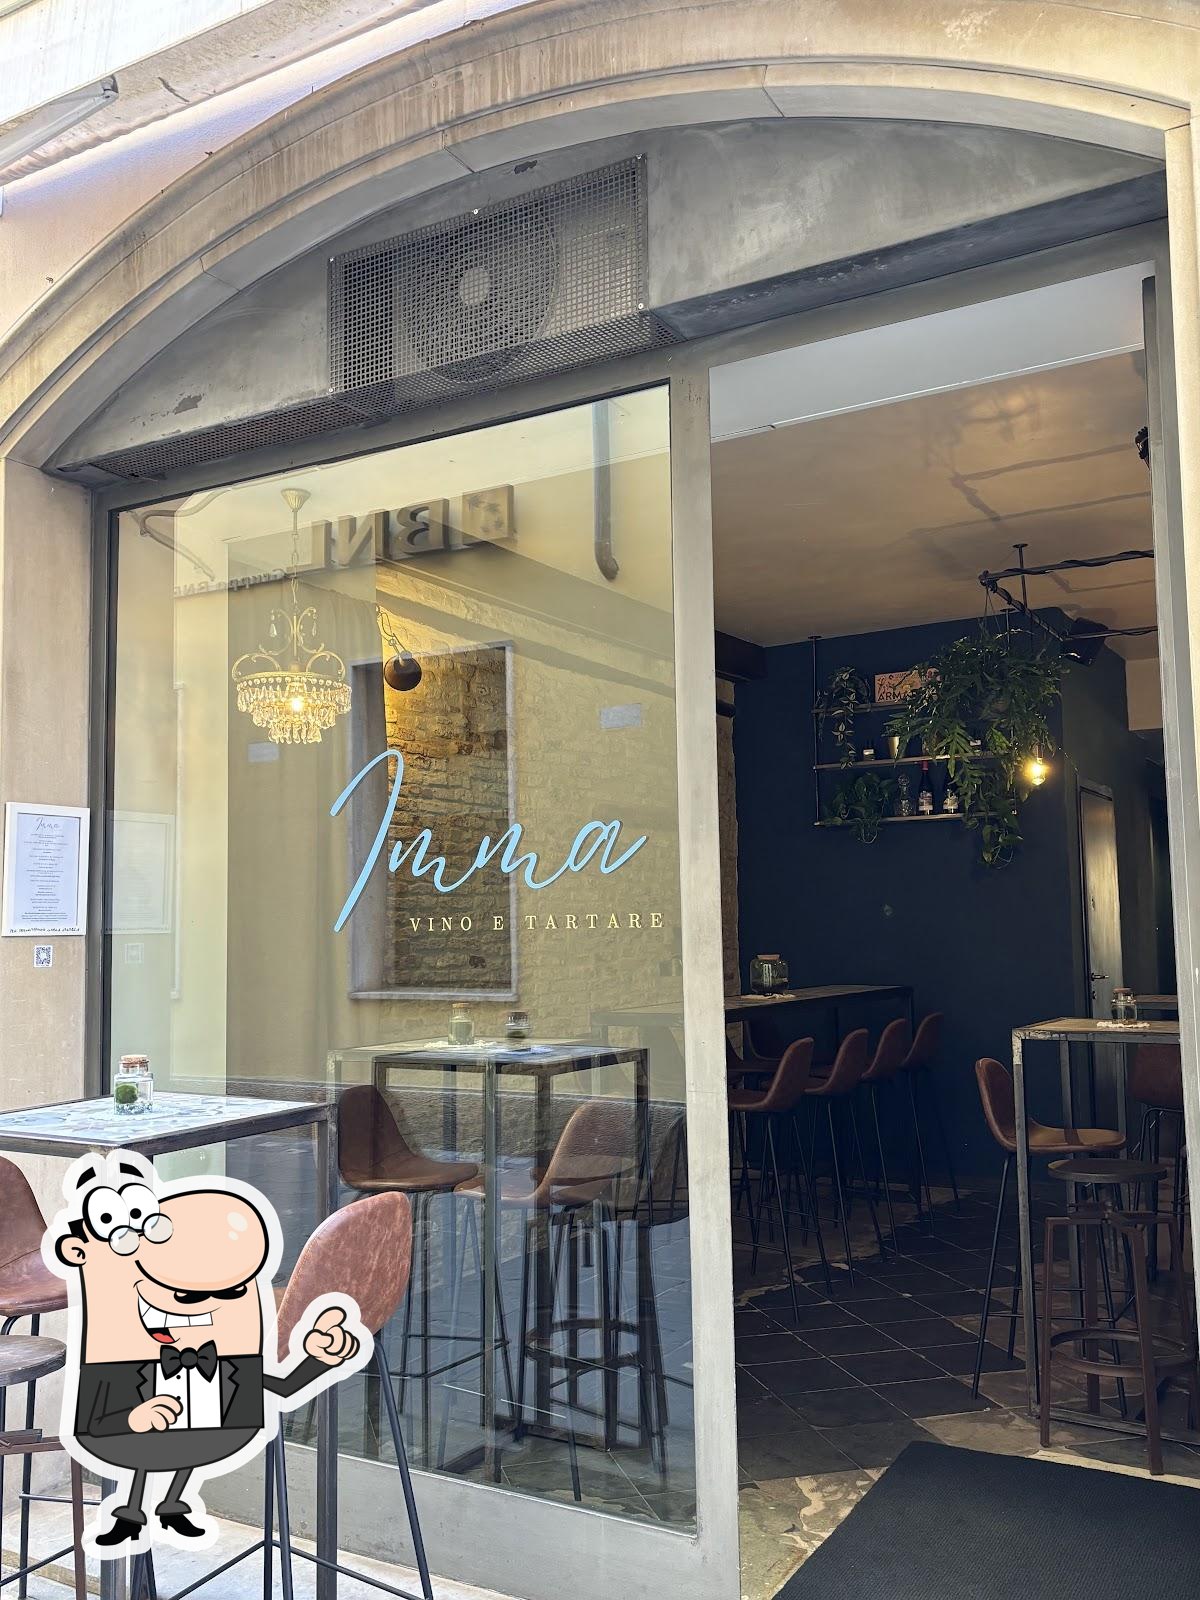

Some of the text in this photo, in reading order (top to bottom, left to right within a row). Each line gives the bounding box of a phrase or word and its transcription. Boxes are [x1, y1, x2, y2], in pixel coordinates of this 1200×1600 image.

[329, 749, 648, 933] Imma
[409, 912, 663, 932] VINO E TARTARE
